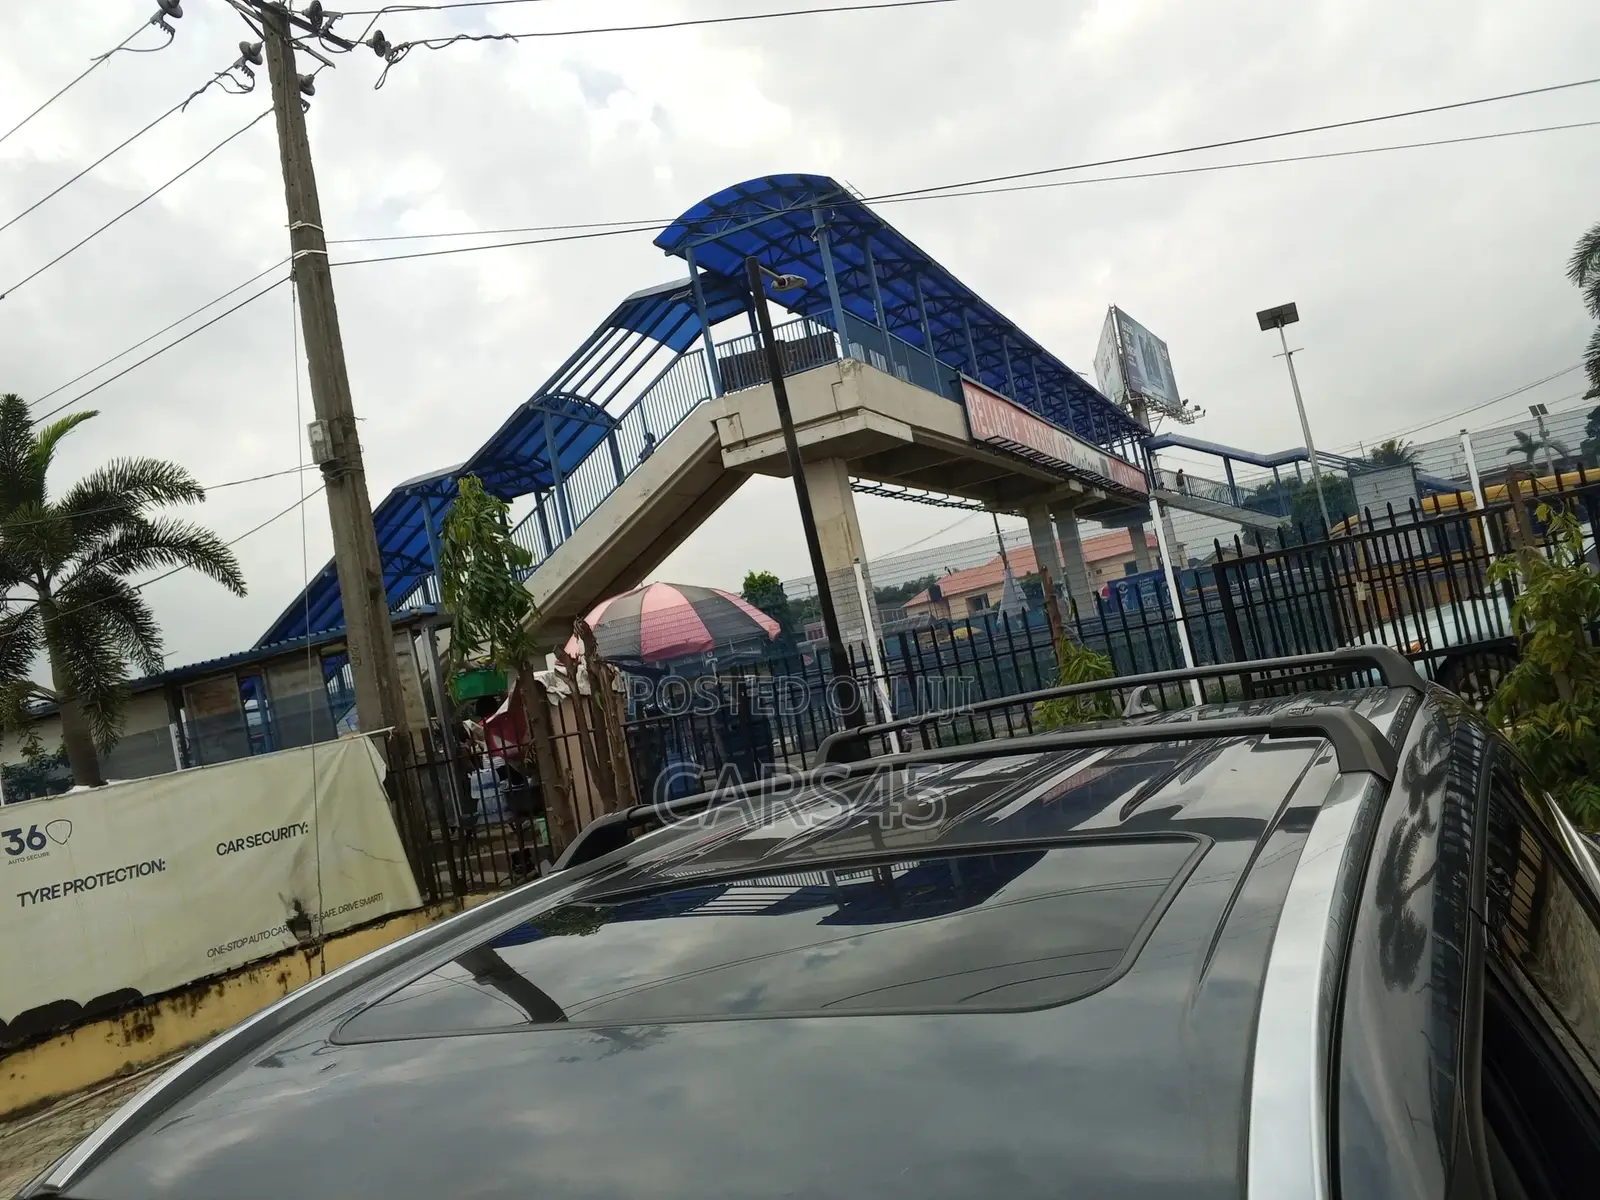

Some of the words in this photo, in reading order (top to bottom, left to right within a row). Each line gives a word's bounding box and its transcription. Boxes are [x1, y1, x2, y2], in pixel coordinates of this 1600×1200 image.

[8, 857, 26, 866] AUTO
[26, 851, 50, 862] SECURE
[216, 838, 246, 856] CAR
[245, 821, 309, 848] SECURITY:
[17, 884, 61, 907] TYRE
[63, 858, 166, 896] PROTECTION:
[207, 937, 248, 958] ONE-STOP
[248, 929, 271, 945] AUTO
[338, 900, 359, 914] DRIVE
